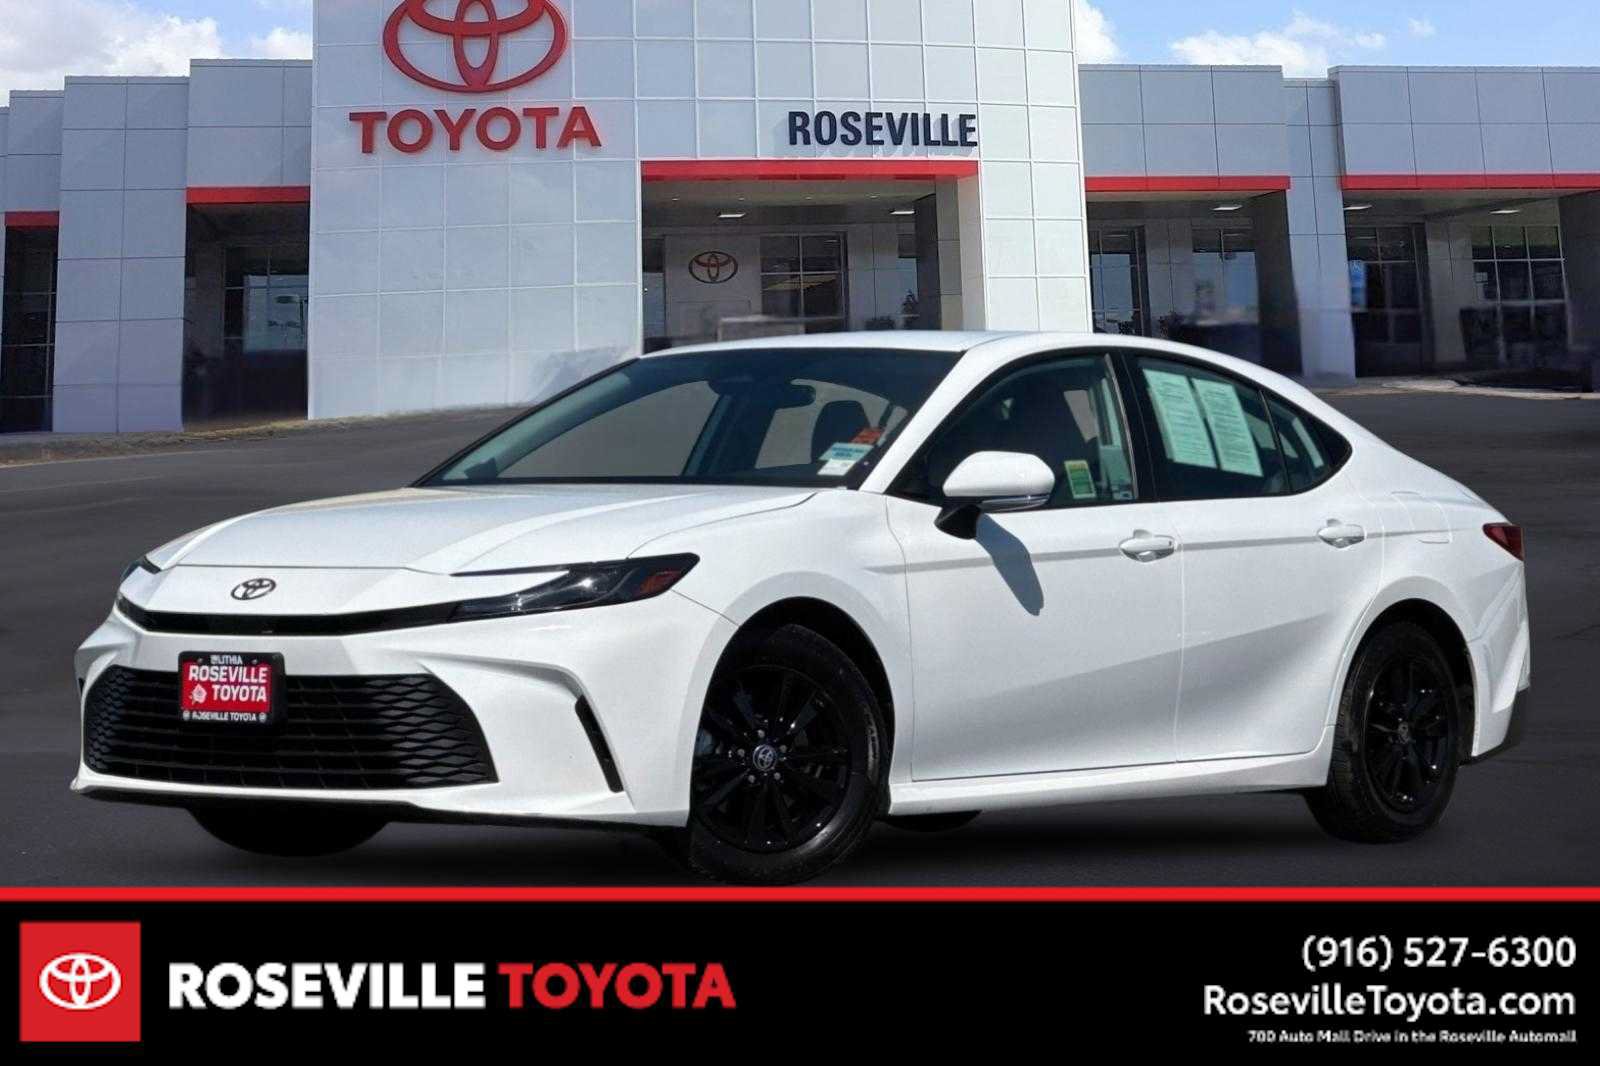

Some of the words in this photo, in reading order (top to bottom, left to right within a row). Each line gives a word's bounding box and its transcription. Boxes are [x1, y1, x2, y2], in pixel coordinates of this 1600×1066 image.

[349, 106, 602, 153] TOYOTA
[788, 111, 978, 147] ROSEVILLE
[188, 664, 268, 684] ROSEVILLE
[211, 684, 268, 703] TOYOTA
[229, 711, 257, 721] TOYOTA
